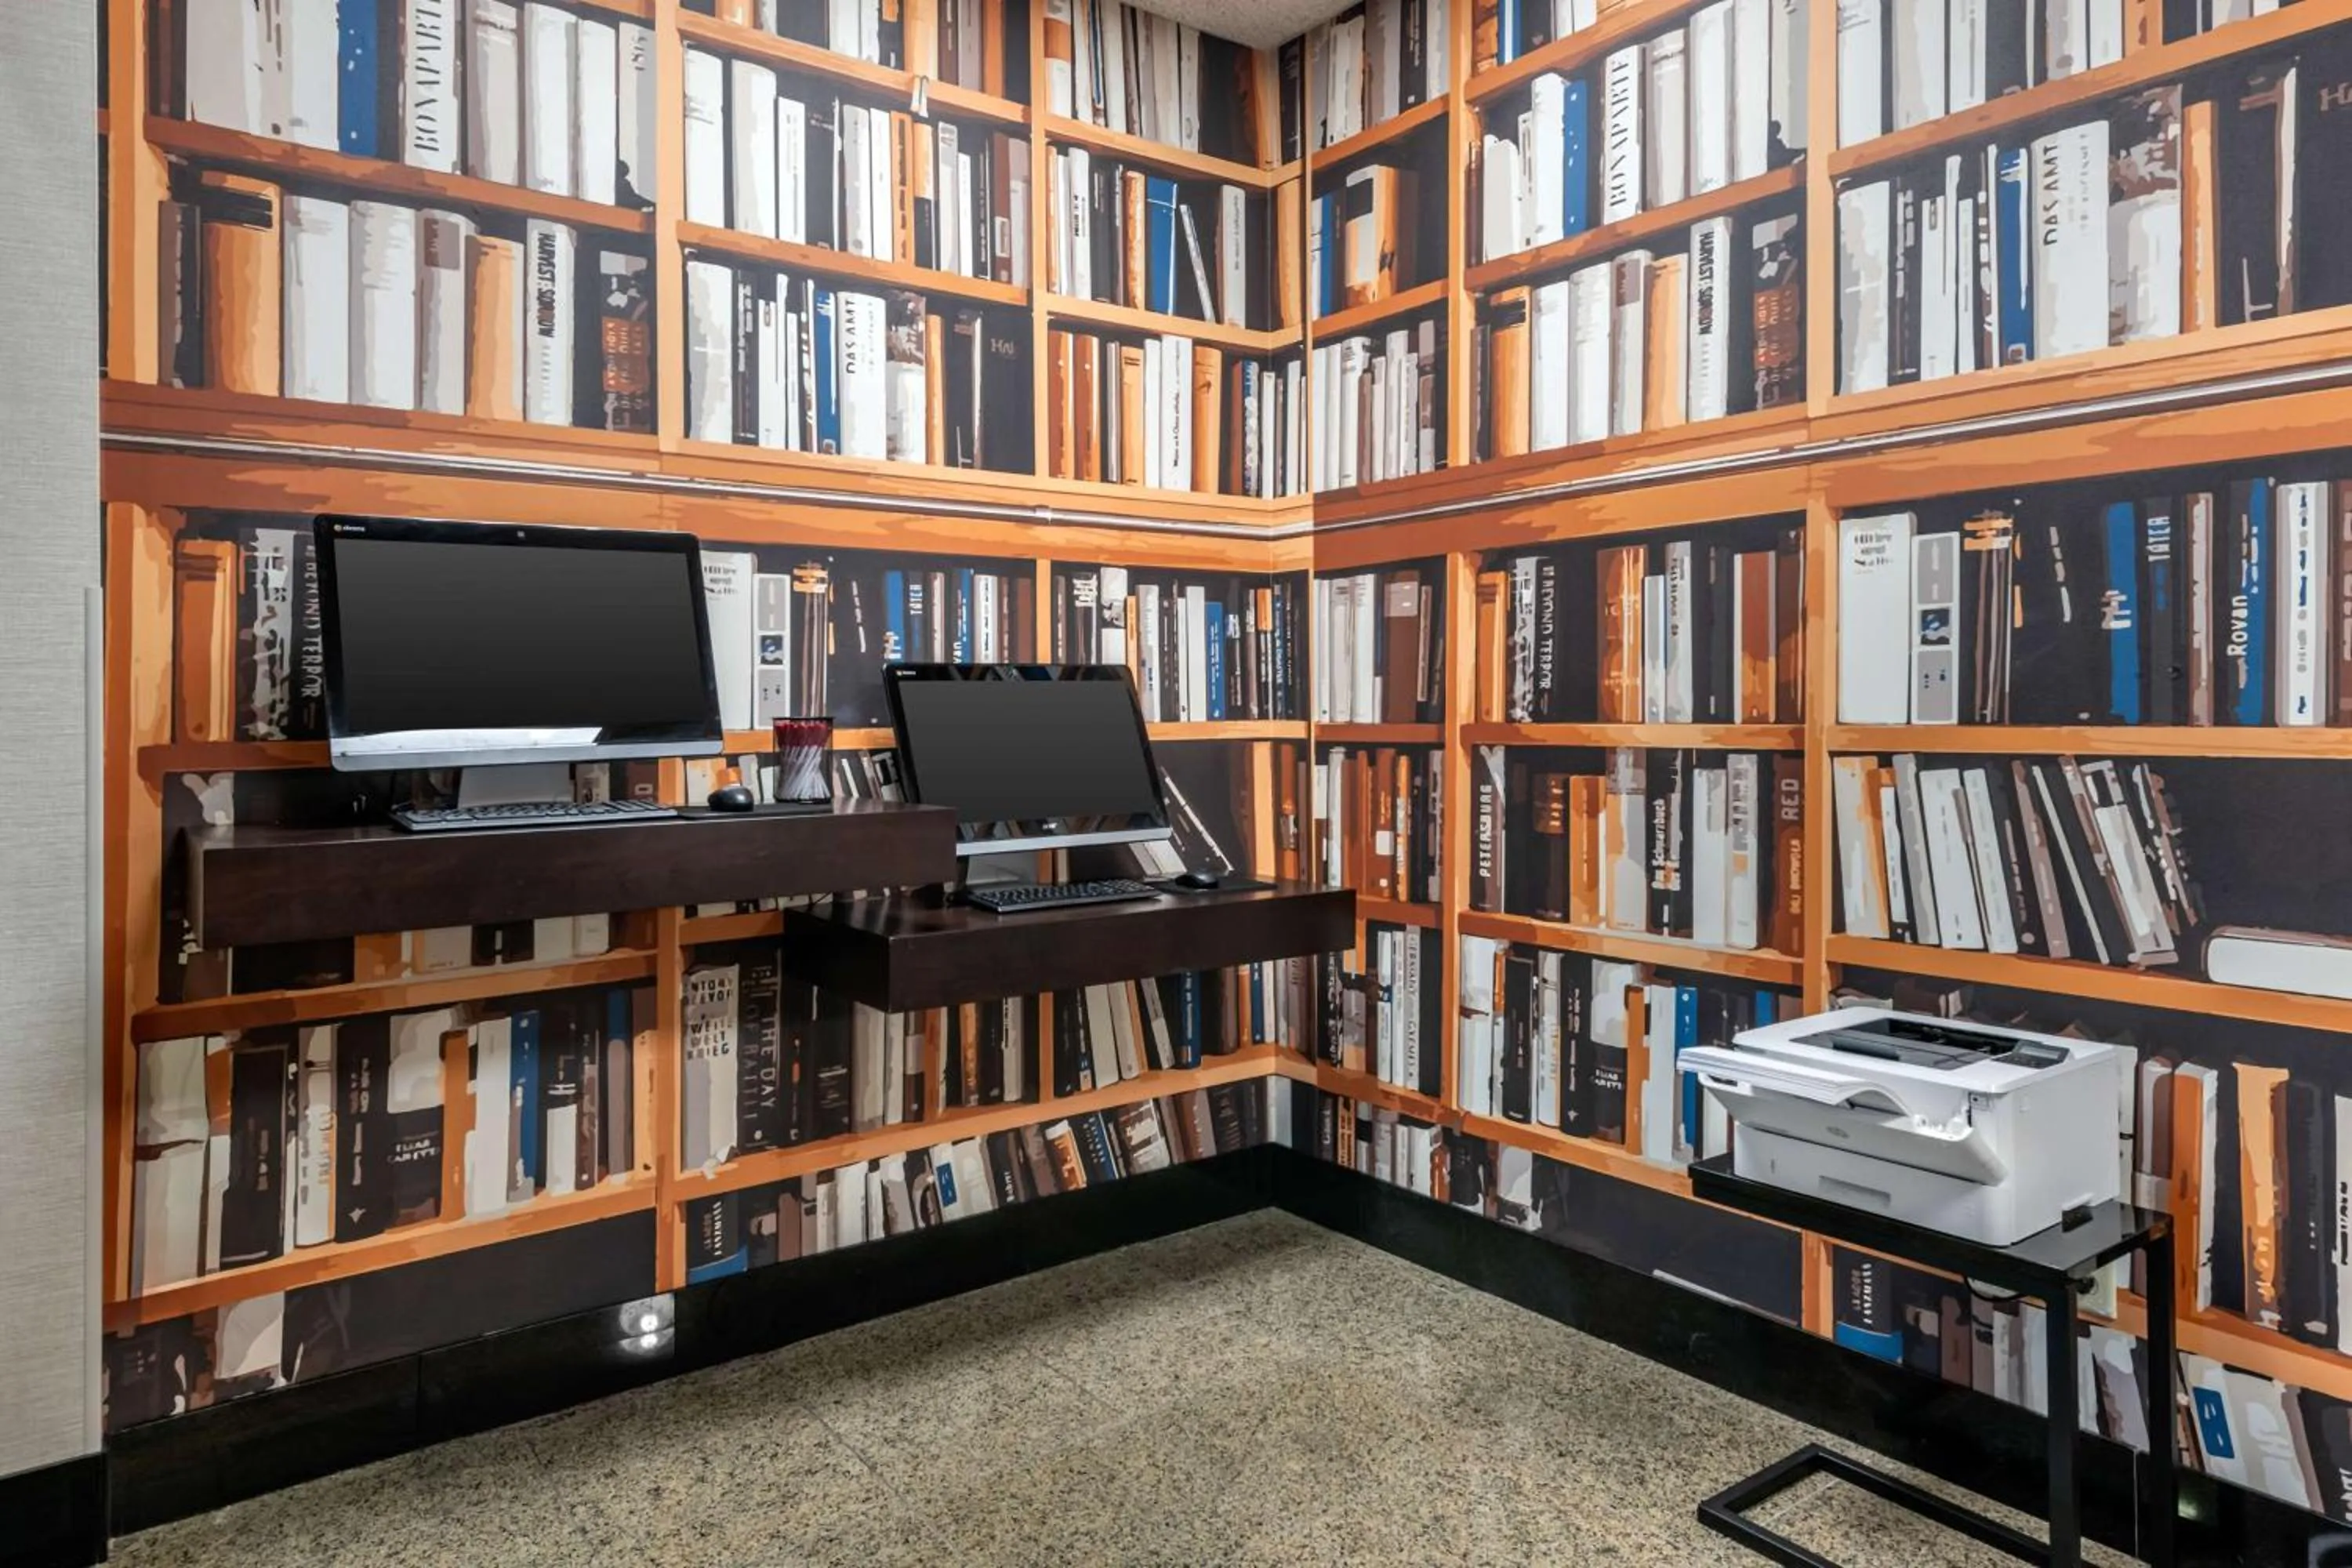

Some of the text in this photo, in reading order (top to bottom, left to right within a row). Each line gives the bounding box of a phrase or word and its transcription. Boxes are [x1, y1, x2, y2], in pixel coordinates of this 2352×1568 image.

[1609, 58, 1631, 207] BONAPARTE
[1479, 784, 1493, 878] PETERSBURG
[1780, 777, 1800, 821] RED
